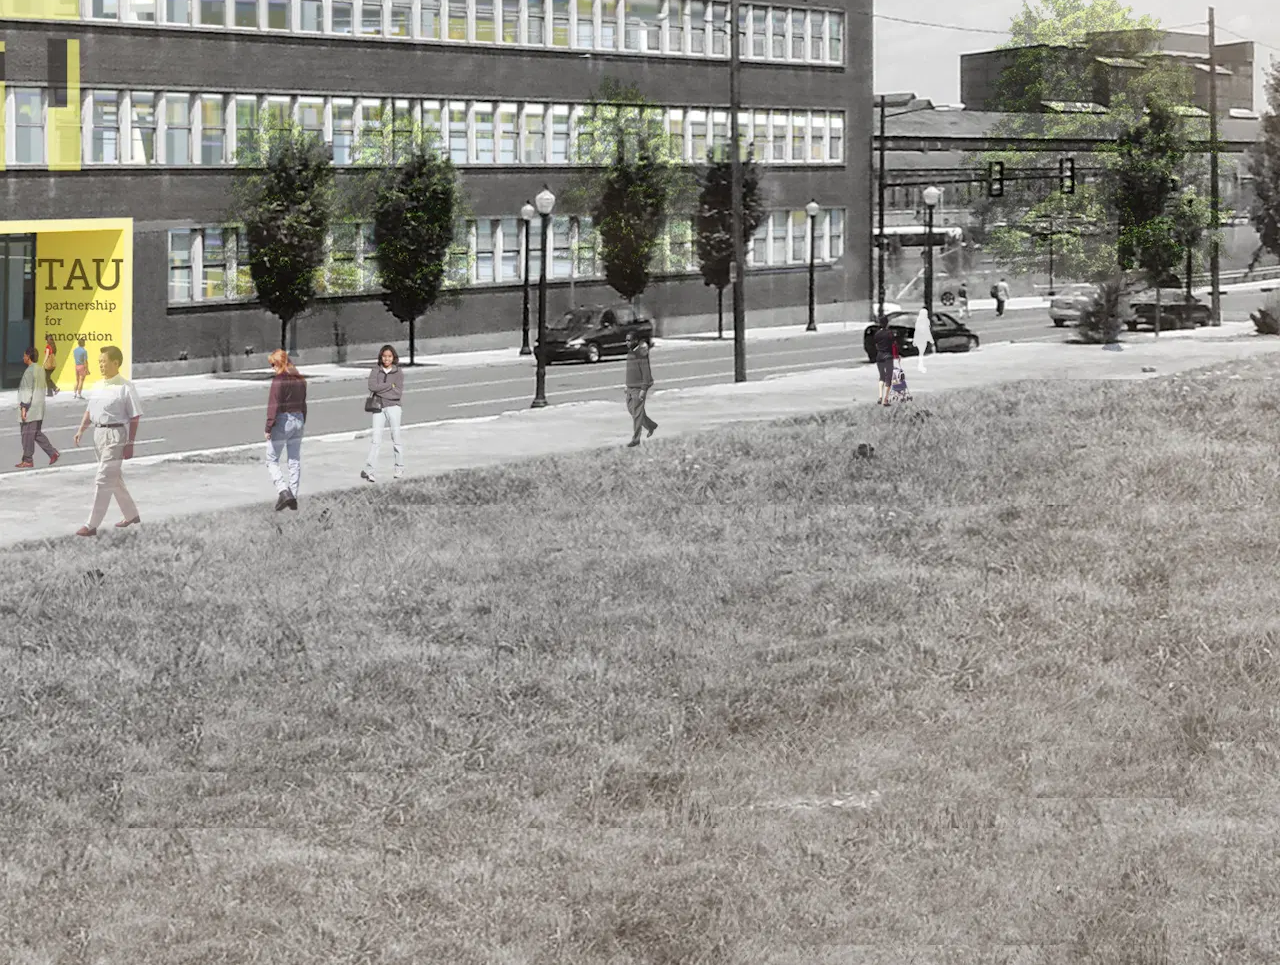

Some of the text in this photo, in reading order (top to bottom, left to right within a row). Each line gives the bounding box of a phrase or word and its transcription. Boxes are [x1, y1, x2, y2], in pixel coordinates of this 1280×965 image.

[38, 259, 123, 290] TAU
[45, 300, 116, 312] partnership
[45, 316, 62, 325] for
[45, 331, 113, 341] innovation
